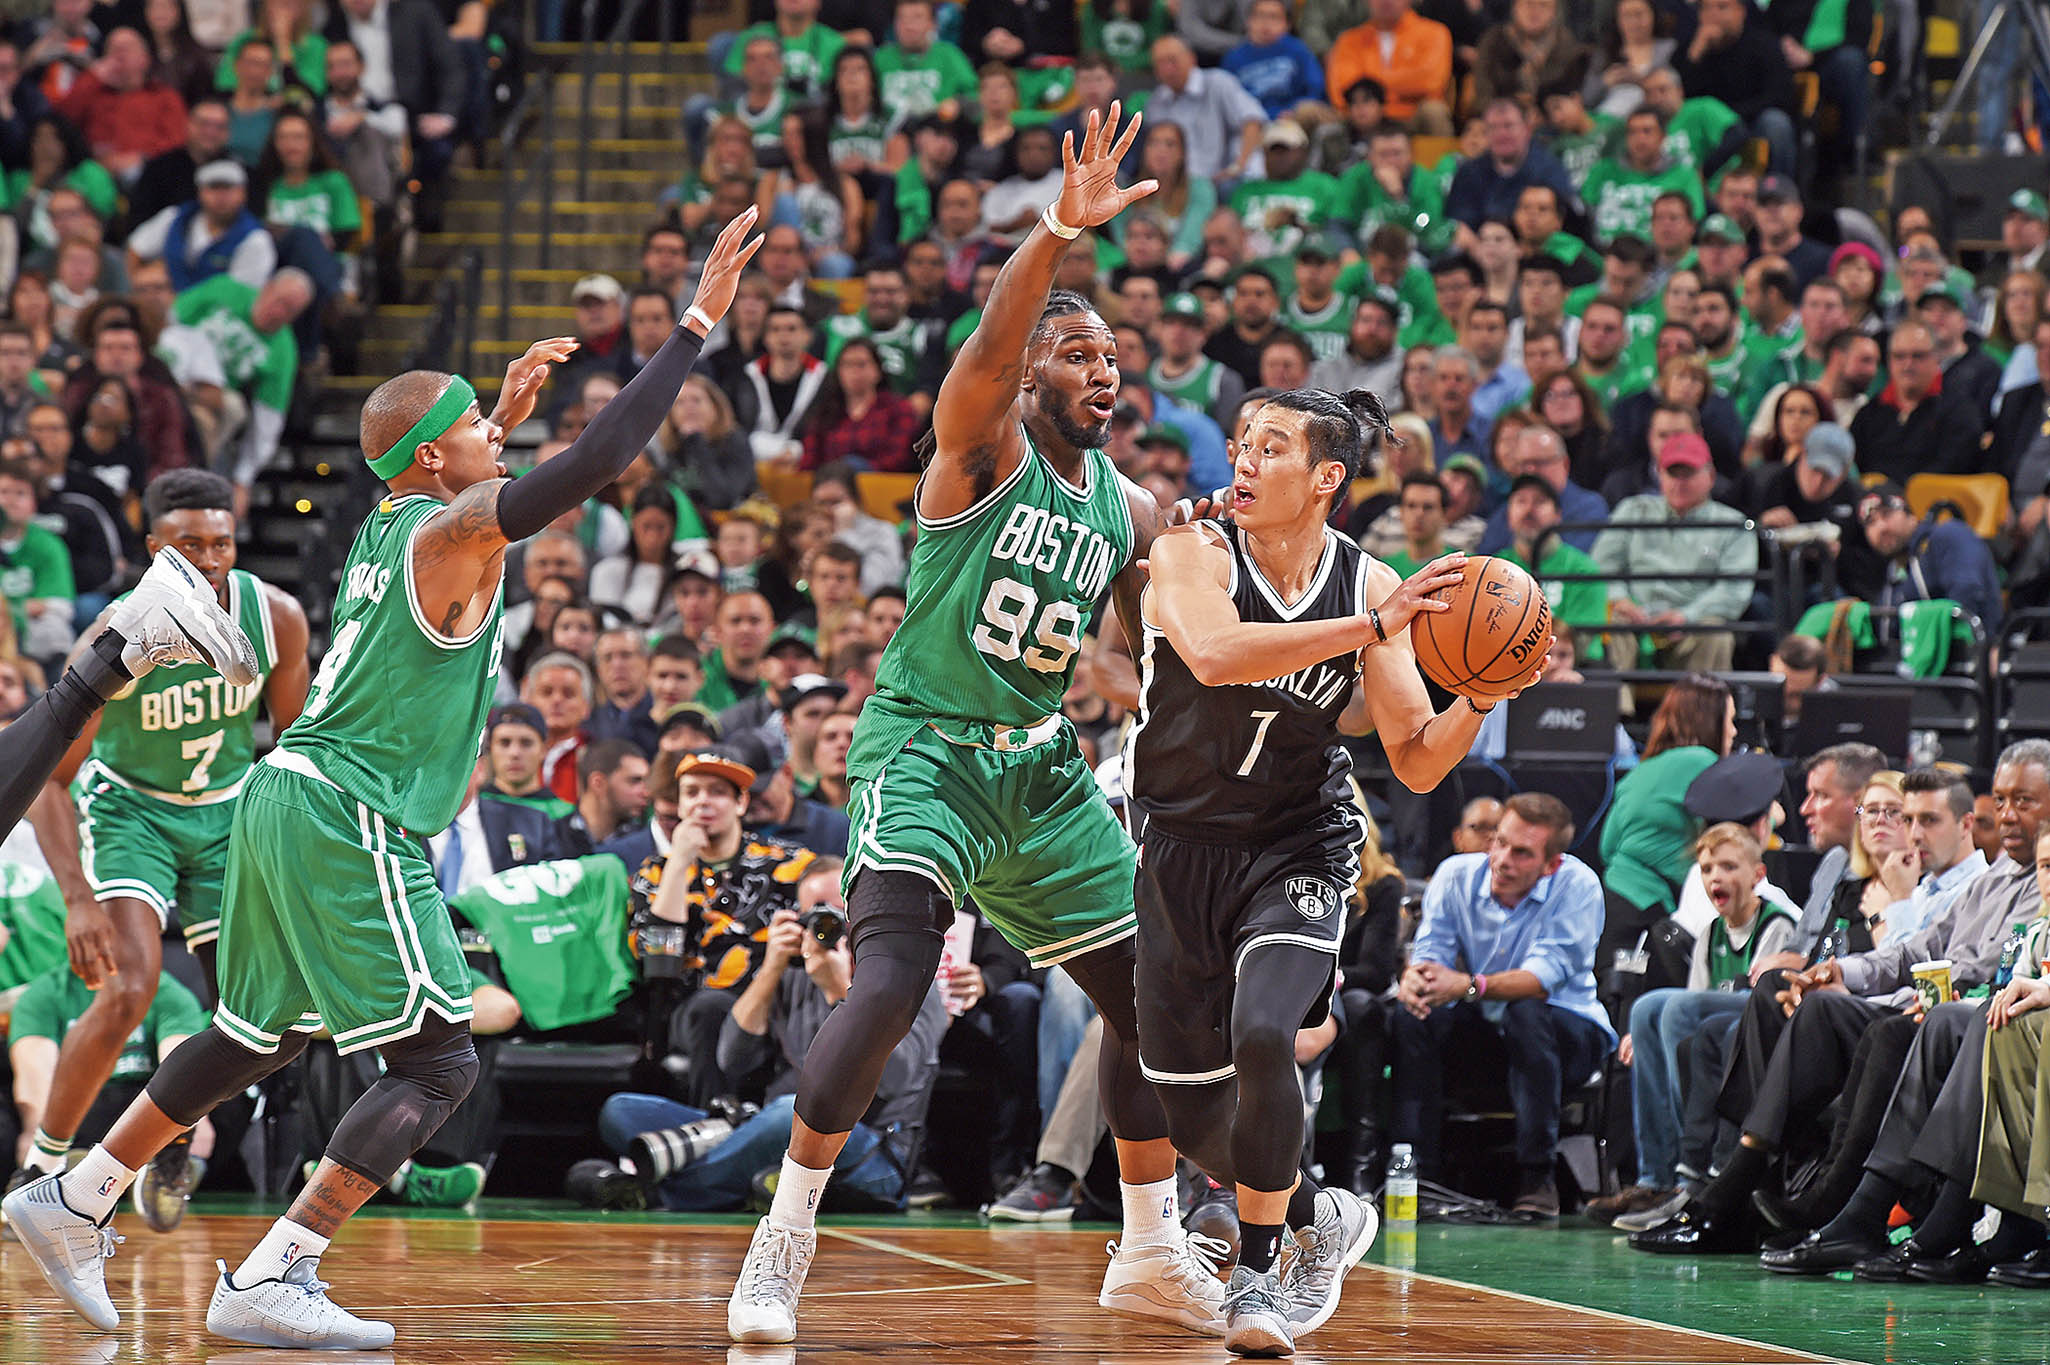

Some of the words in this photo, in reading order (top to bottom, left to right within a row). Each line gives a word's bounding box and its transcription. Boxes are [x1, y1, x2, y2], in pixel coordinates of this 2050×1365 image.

[992, 503, 1117, 602] BOSTON
[973, 577, 1081, 673] 99
[181, 728, 225, 792] 7
[1236, 710, 1280, 776] 7
[1289, 879, 1334, 906] NETS
[1307, 898, 1316, 913] B
